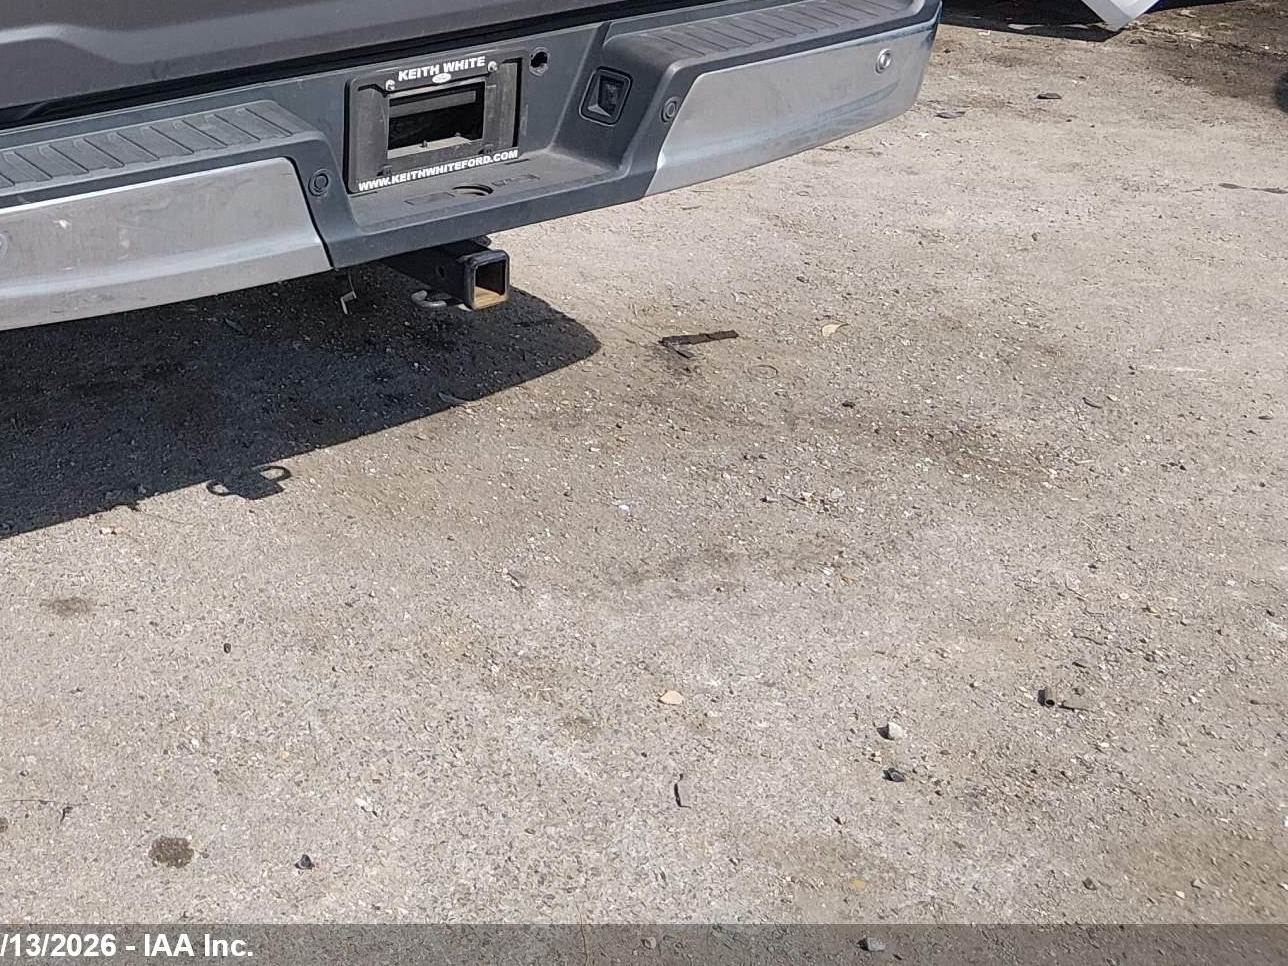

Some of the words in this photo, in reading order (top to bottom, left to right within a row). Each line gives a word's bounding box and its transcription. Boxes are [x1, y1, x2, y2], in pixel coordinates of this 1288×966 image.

[398, 64, 439, 82] KEITH
[443, 56, 485, 73] WHITE
[358, 149, 519, 191] WWW.KEITHWHITEFORD.COM
